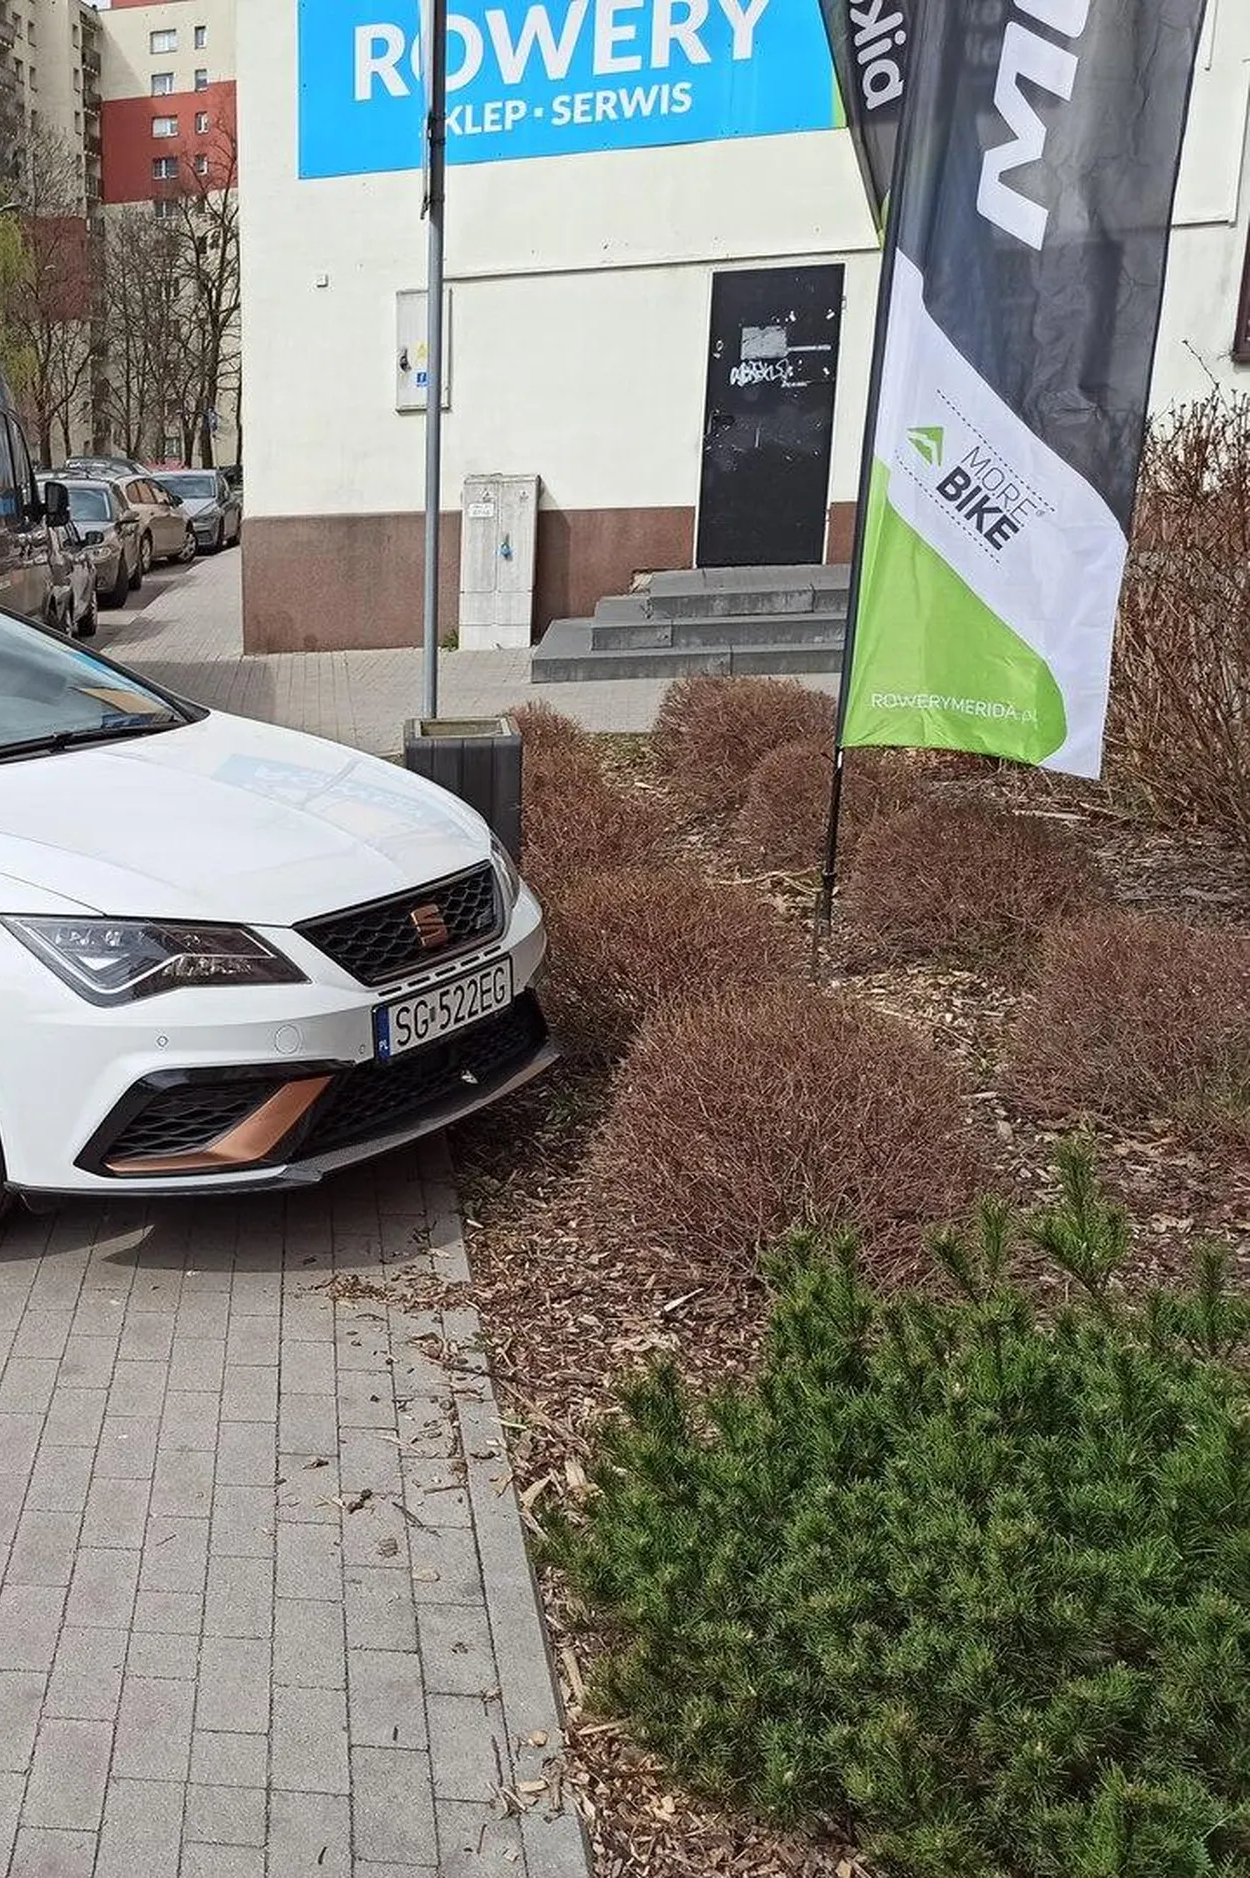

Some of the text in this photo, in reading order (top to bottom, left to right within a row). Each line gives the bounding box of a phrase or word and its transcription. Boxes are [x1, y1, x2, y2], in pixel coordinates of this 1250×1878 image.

[354, 0, 771, 101] ROWERY
[421, 98, 527, 137] KLEP
[551, 81, 693, 126] SERWIS
[936, 466, 1020, 551] BIKE
[396, 966, 506, 1047] SG 522EG
